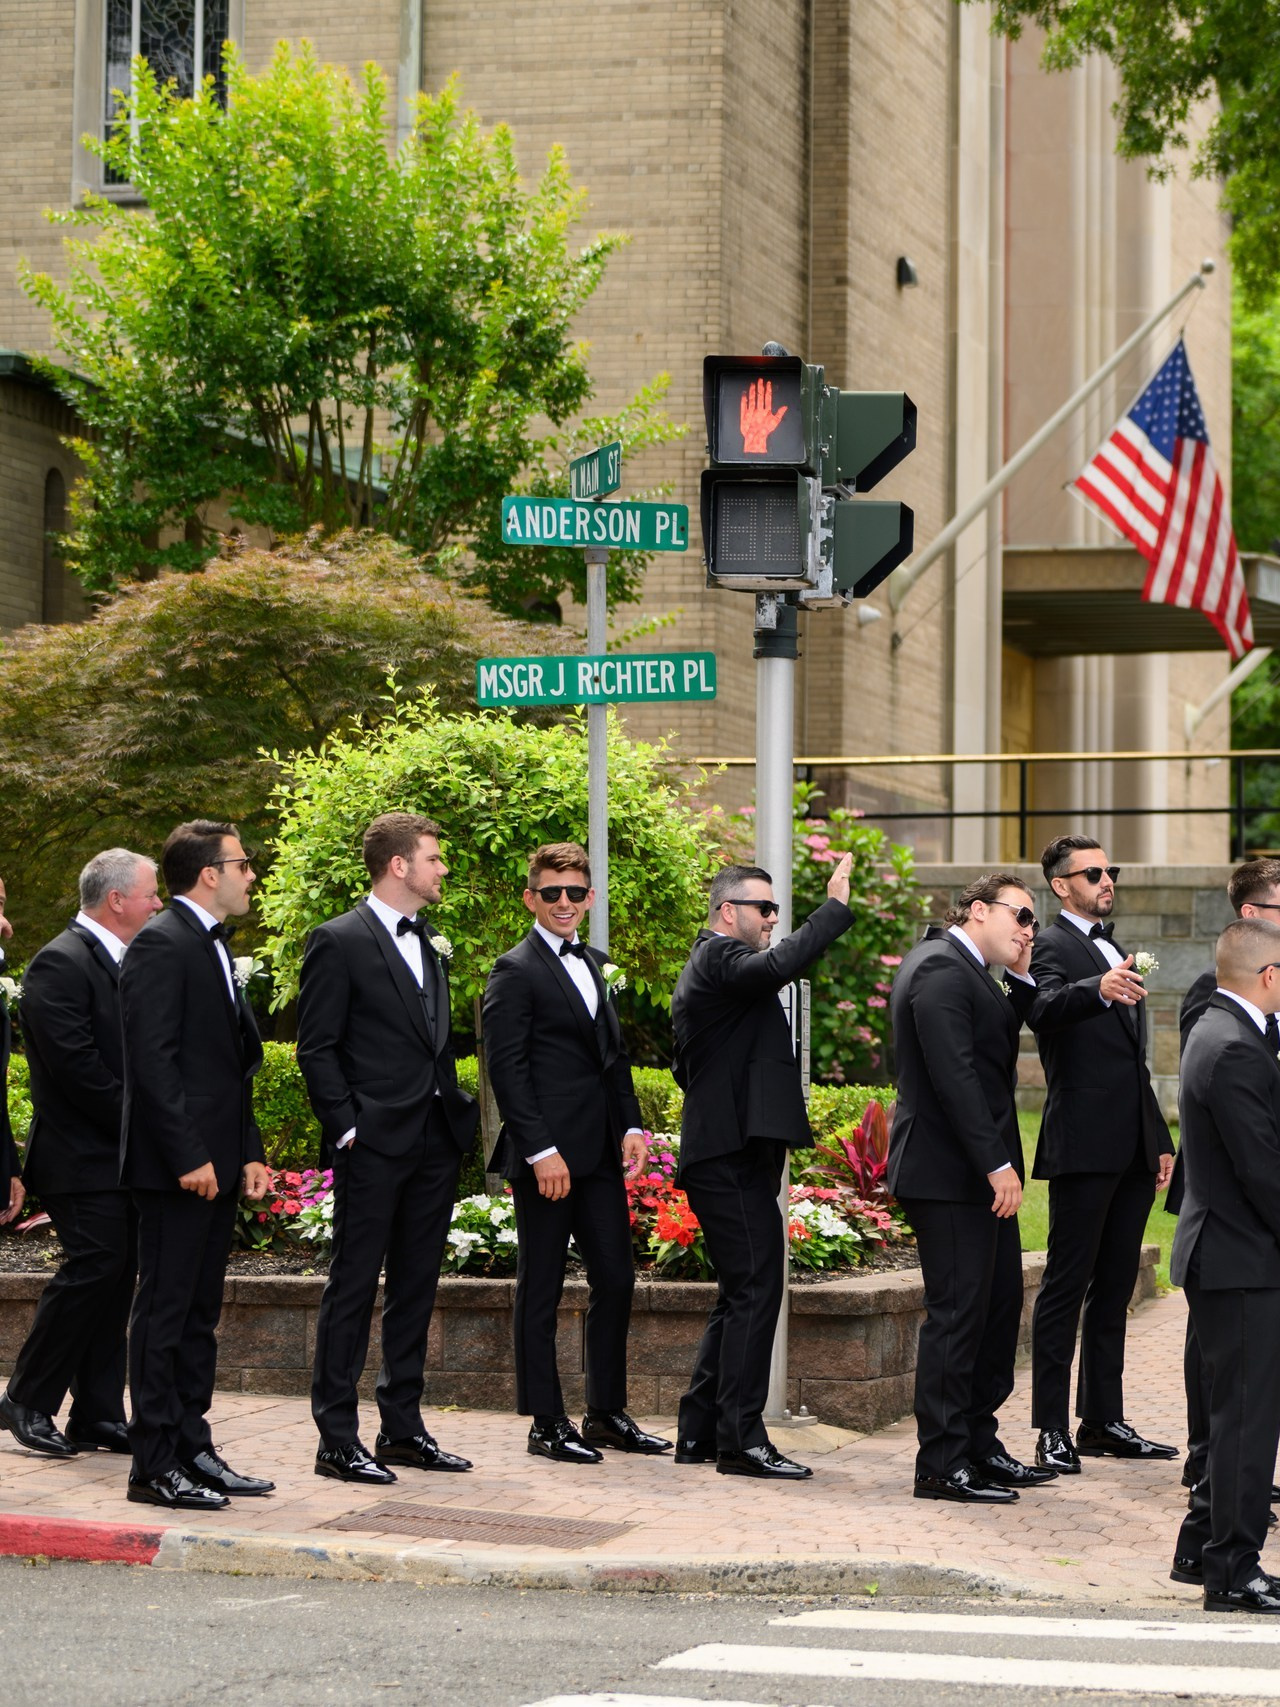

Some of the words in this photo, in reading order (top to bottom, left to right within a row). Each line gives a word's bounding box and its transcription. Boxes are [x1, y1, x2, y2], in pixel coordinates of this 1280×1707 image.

[580, 457, 599, 498] MAIN
[608, 449, 619, 485] ST
[506, 505, 641, 543] ANDERSON
[656, 511, 685, 545] PL
[479, 664, 547, 699] MSGR.
[550, 662, 567, 697] J.
[578, 660, 675, 695] RICHTER
[683, 658, 714, 693] PL
